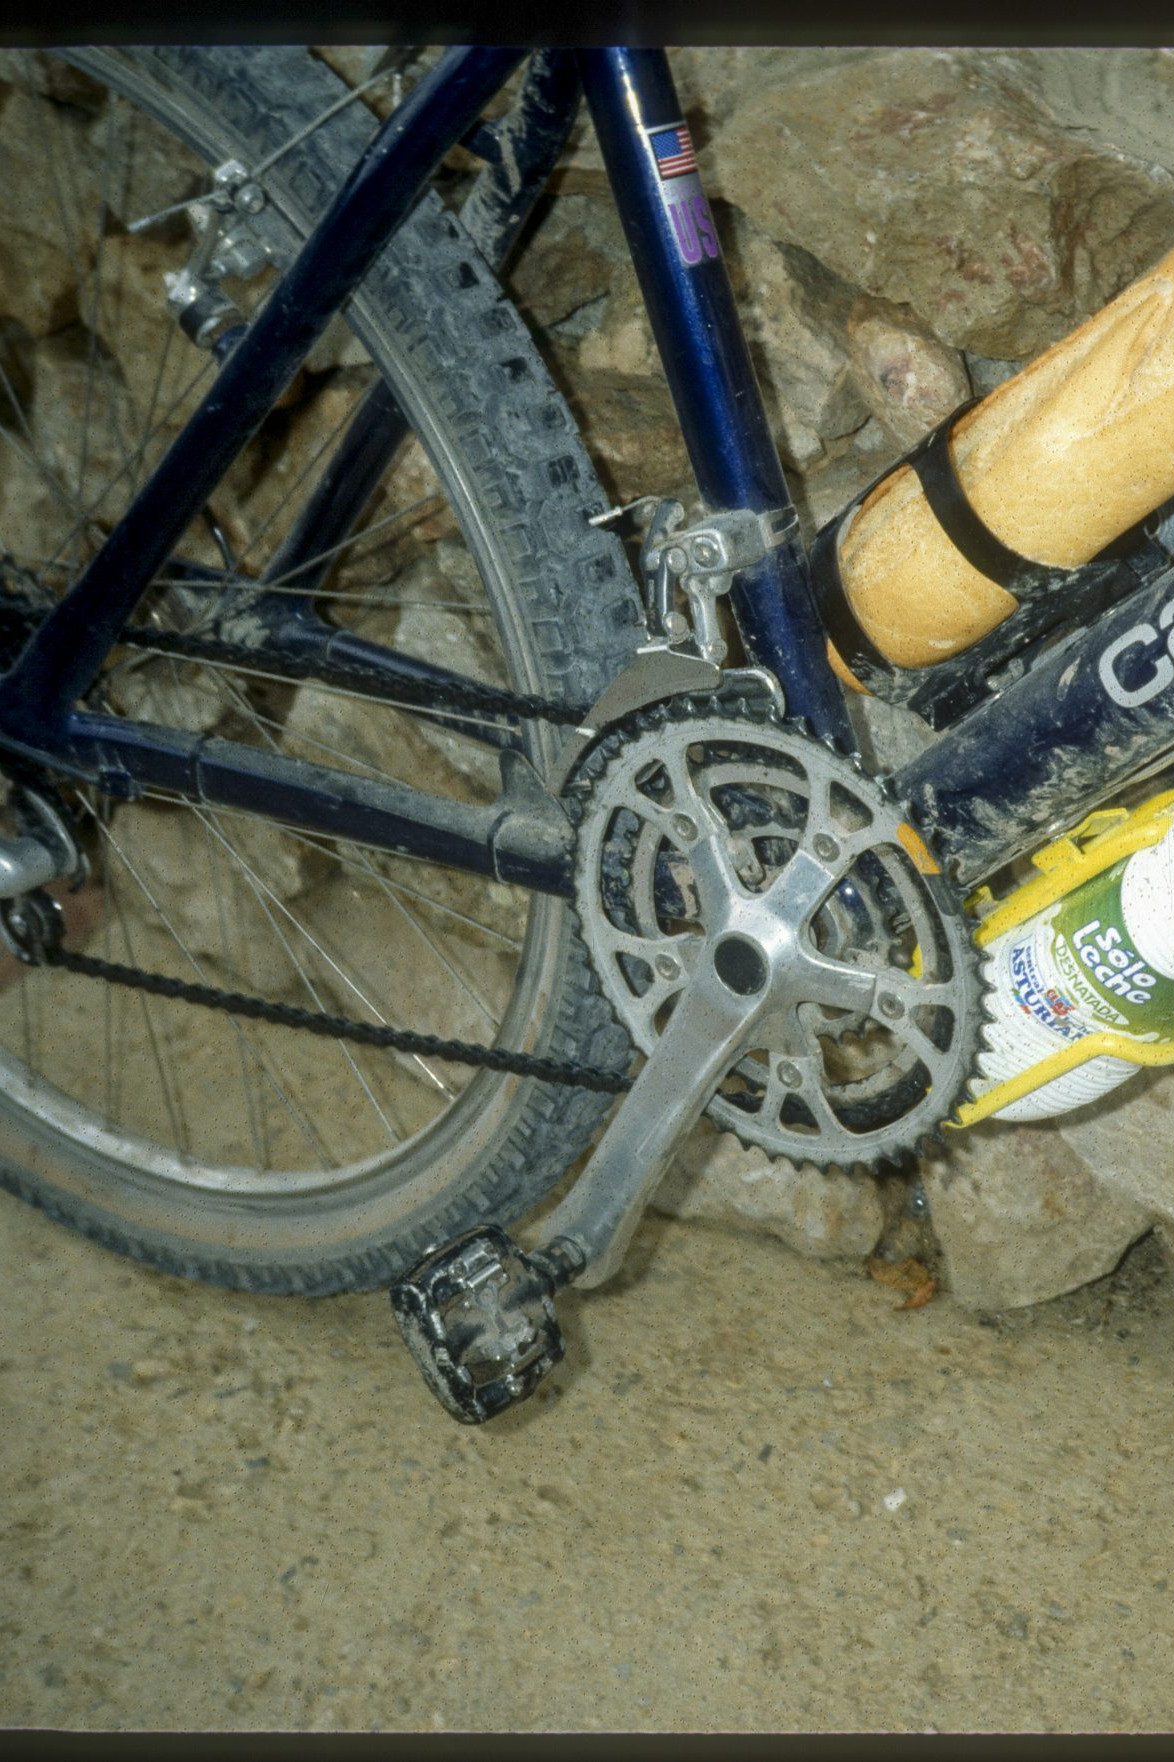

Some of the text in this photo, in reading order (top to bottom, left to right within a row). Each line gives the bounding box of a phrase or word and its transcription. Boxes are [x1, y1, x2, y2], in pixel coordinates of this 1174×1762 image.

[1056, 944, 1120, 1023] DESNATADA
[1072, 919, 1152, 1004] Leche
[1095, 927, 1157, 988] Sólo
